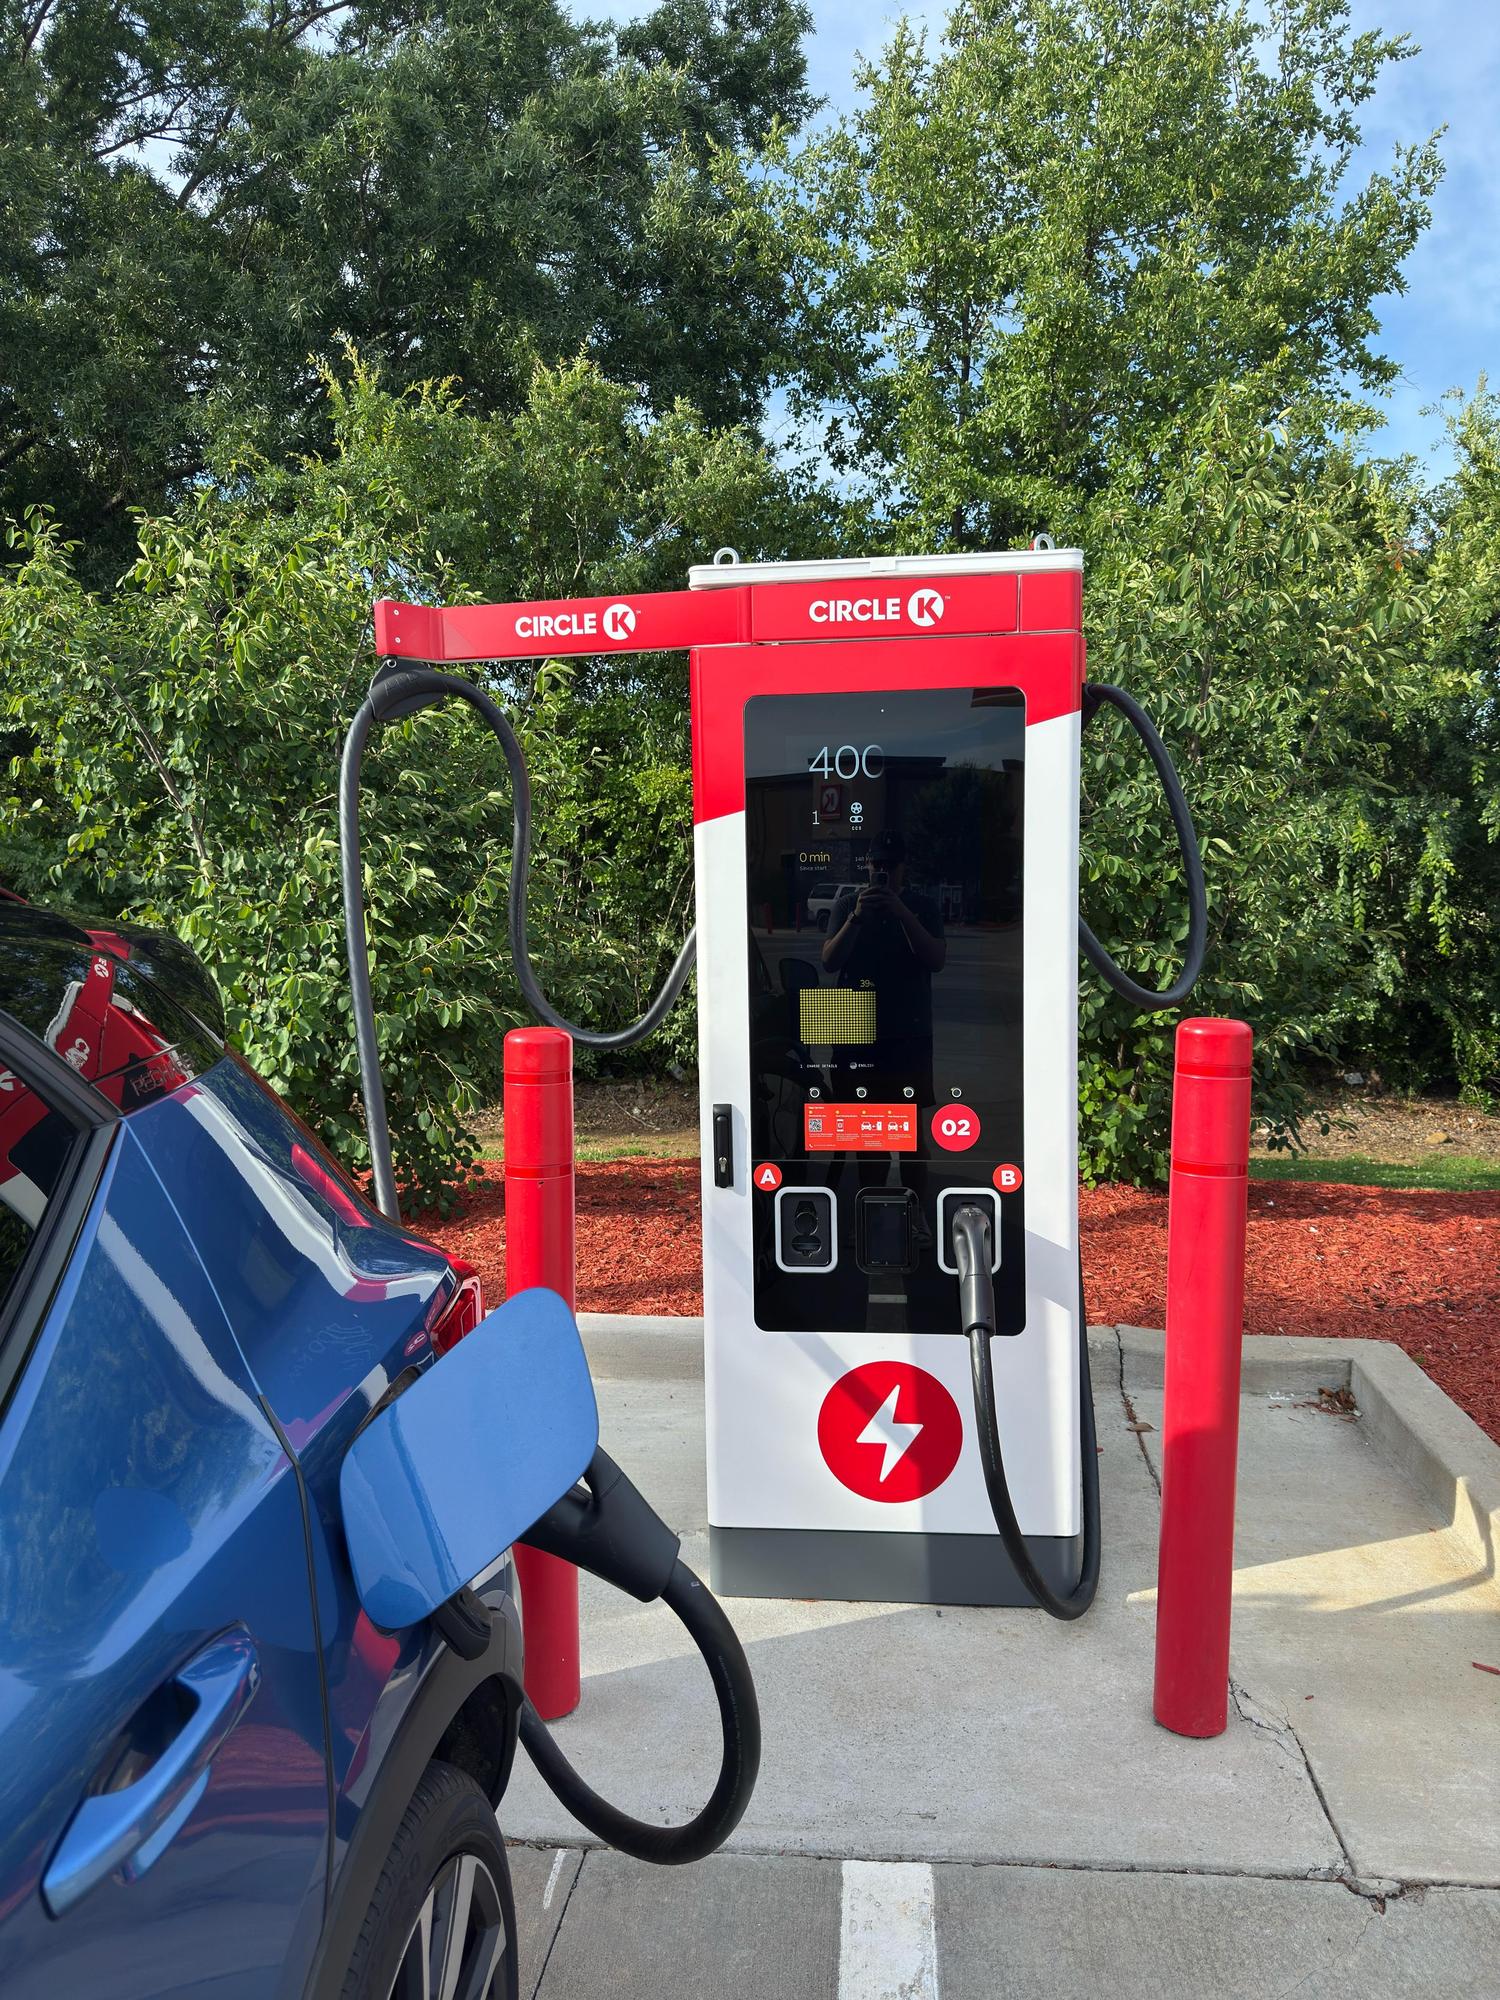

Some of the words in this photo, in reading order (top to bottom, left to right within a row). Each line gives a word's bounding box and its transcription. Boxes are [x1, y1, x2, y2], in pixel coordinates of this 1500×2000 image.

[808, 597, 901, 623] CIRCLE
[909, 589, 945, 627] K
[515, 613, 597, 638] CIRCLE
[605, 604, 636, 640] K
[799, 852, 807, 863] 0
[809, 851, 831, 862] min
[941, 1119, 971, 1137] 02
[759, 1168, 777, 1185] A
[1000, 1170, 1016, 1186] B
